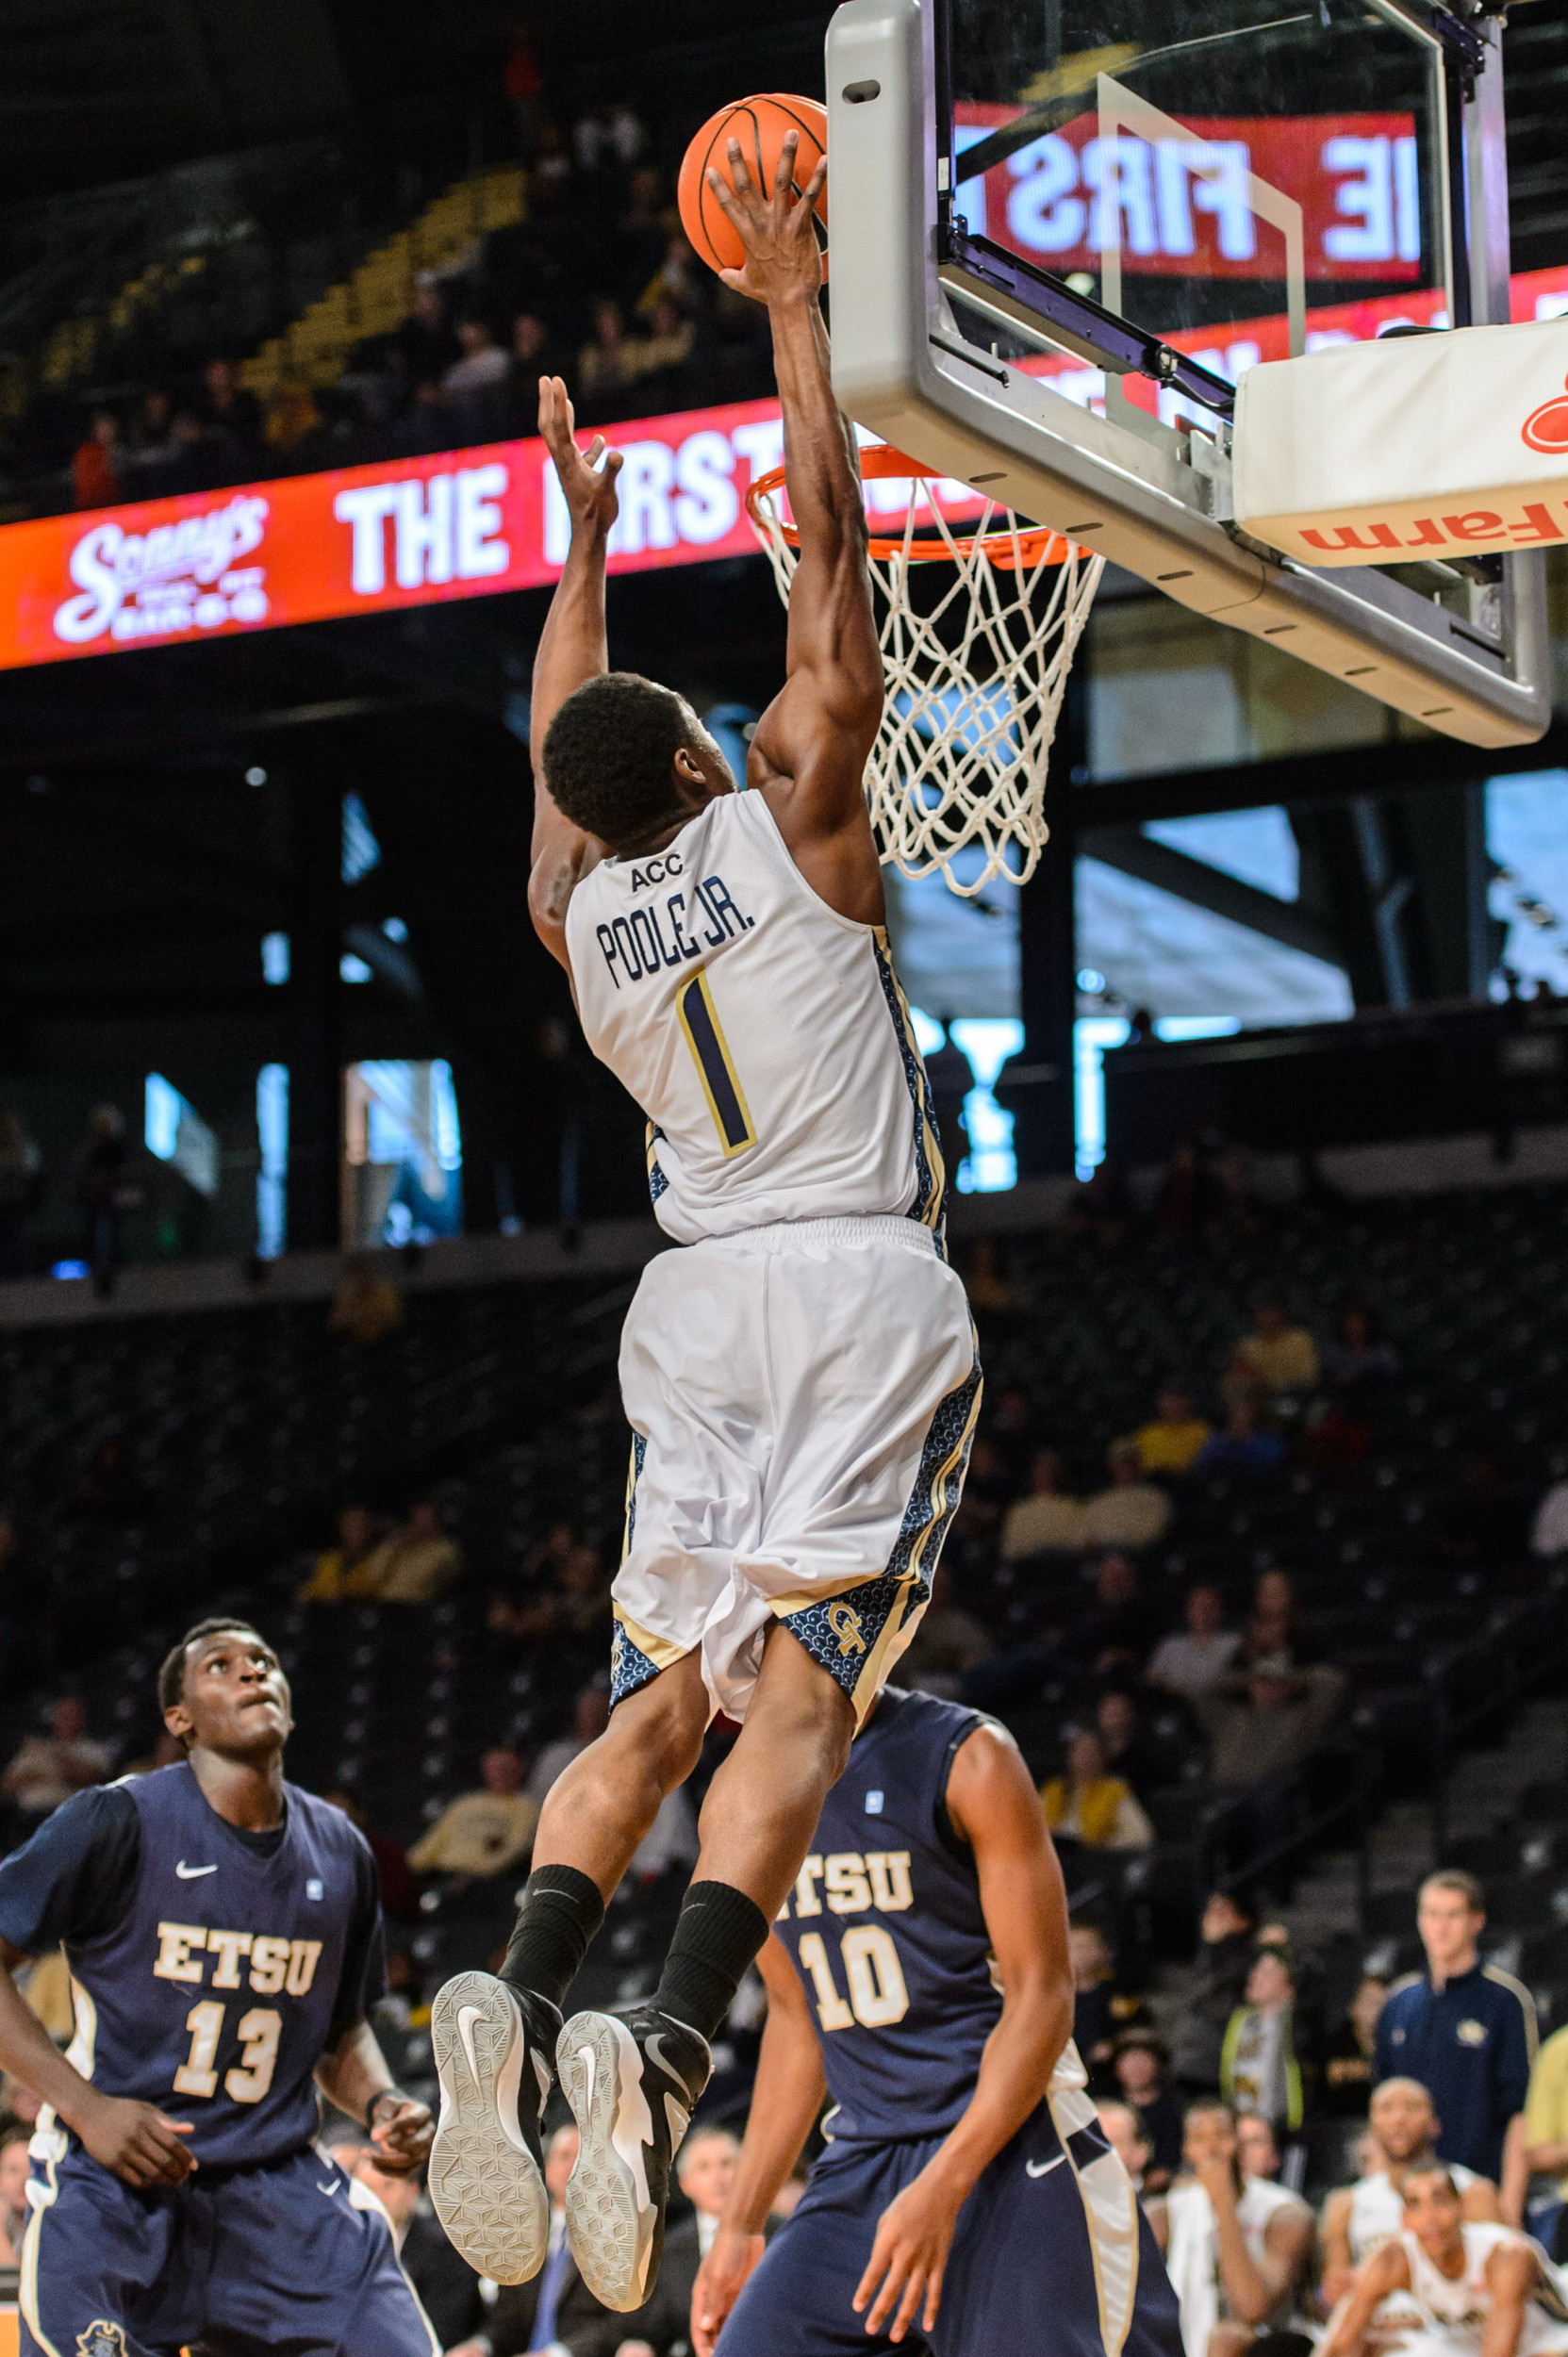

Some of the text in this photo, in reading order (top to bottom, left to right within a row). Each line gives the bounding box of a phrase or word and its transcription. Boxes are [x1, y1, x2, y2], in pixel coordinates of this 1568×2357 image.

[334, 464, 509, 595] THE
[1297, 503, 1565, 551] Farm
[632, 853, 683, 893] ACC
[596, 875, 755, 989] POOLE JR.
[676, 963, 757, 1158] 1
[775, 1851, 914, 1921] TSU
[153, 1921, 323, 1996] ETSU
[798, 1923, 910, 2033] 10
[173, 2000, 282, 2103] 13
